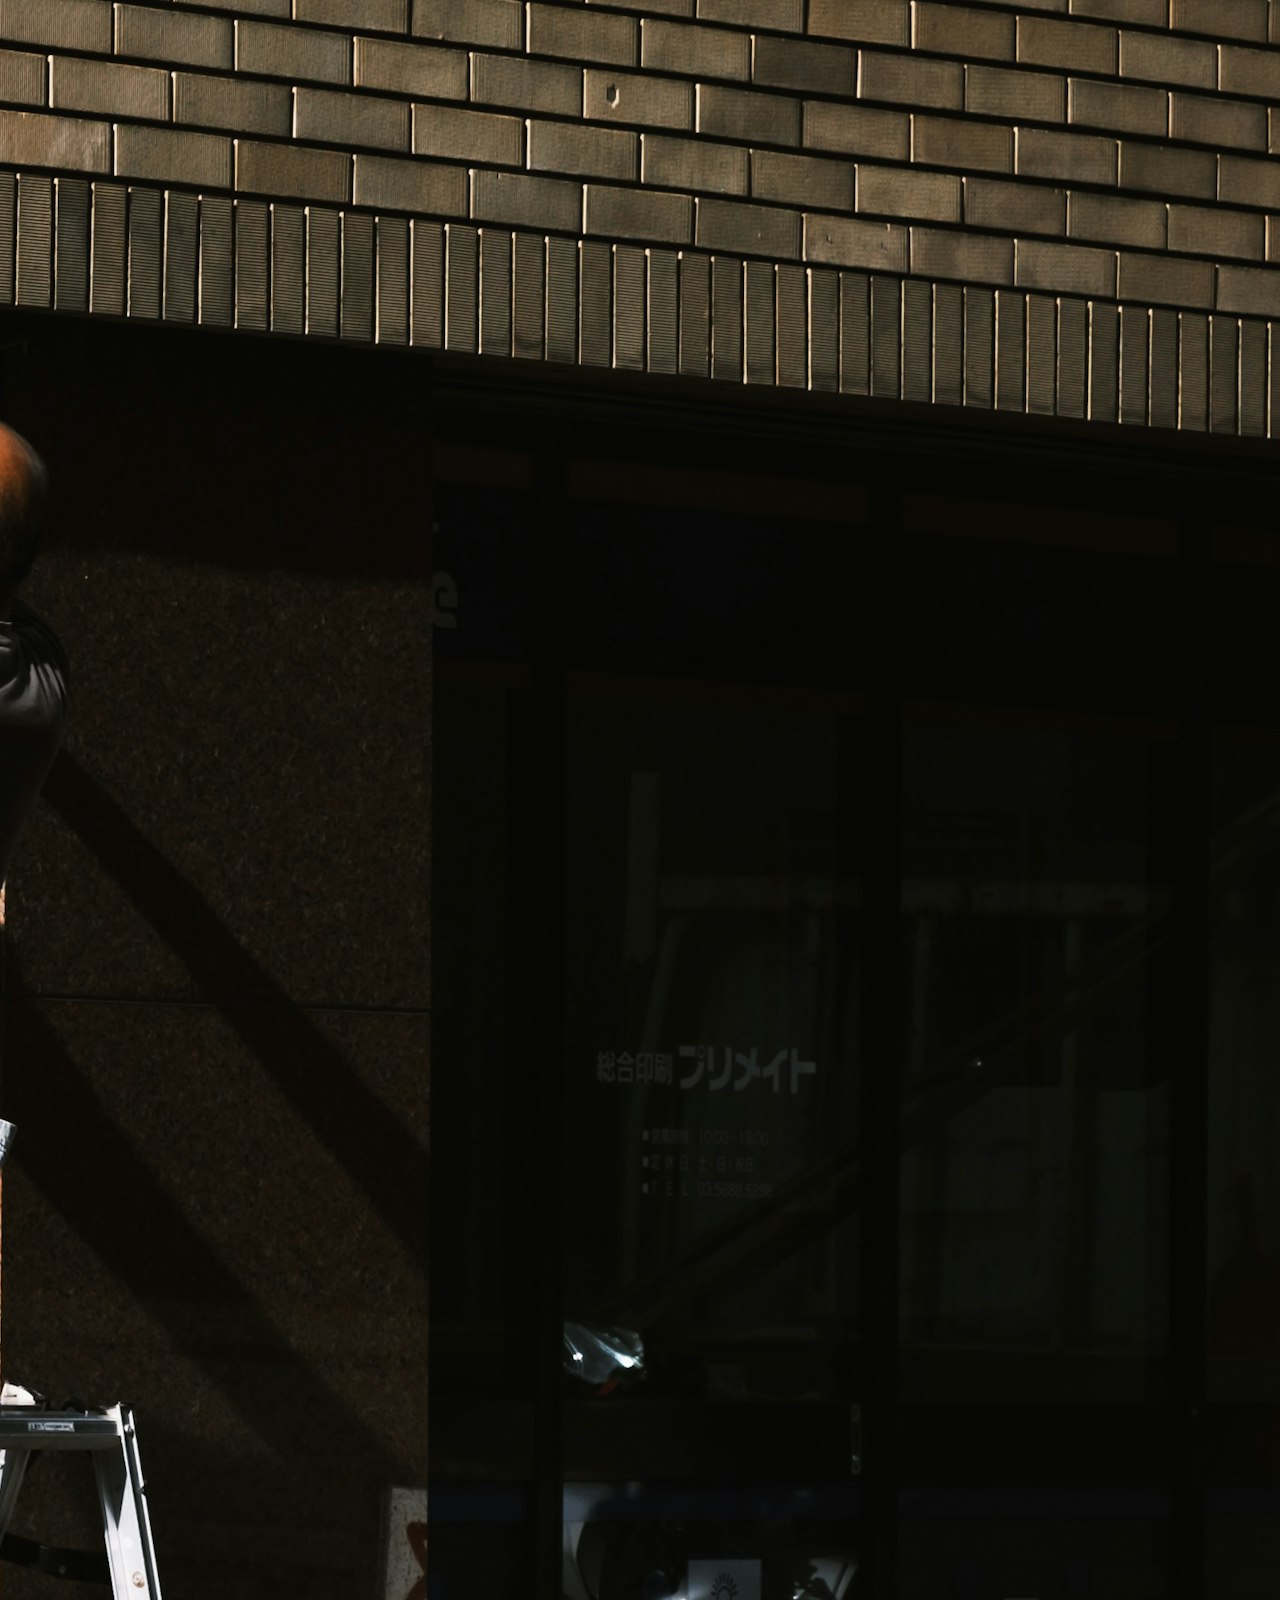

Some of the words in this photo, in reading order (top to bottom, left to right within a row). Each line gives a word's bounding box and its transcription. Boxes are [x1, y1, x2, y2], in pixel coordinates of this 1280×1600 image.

[596, 1050, 674, 1085] 総合印刷
[678, 1044, 817, 1094] プリメイト
